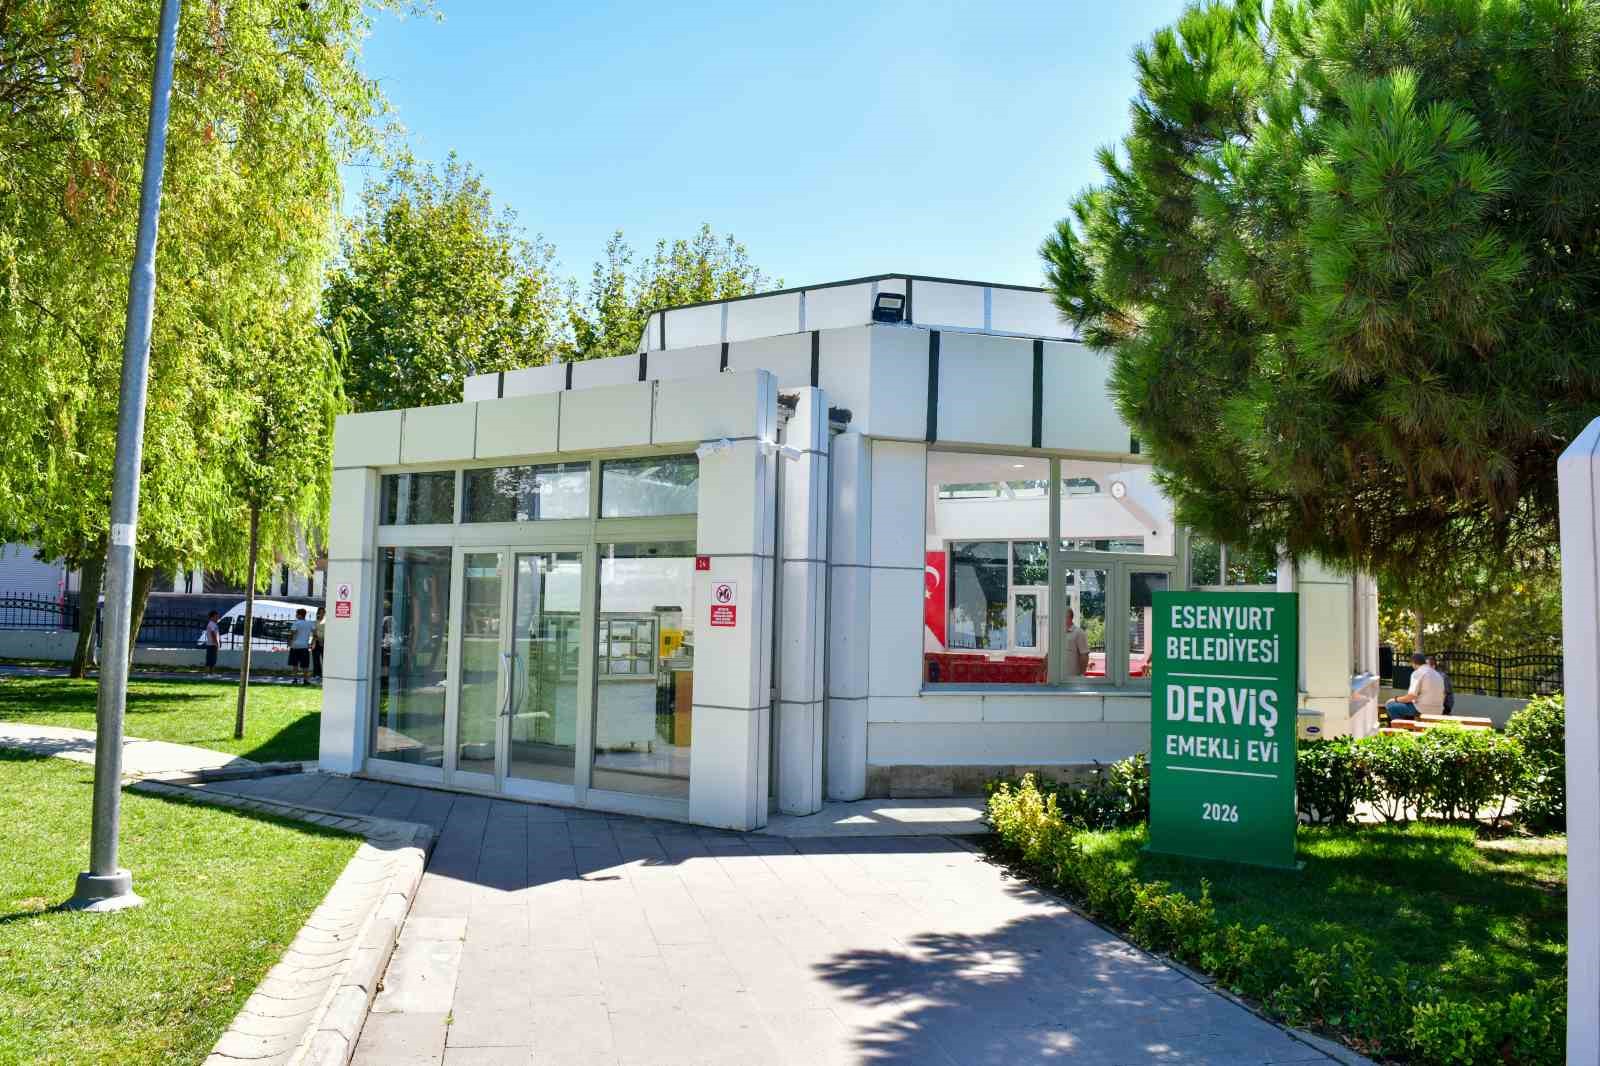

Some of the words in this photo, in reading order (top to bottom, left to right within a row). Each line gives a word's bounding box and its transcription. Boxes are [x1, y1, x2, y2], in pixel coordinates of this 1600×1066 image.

[1171, 606, 1275, 631] ESENYURT
[1167, 634, 1279, 663] BELEDİYESİ
[1166, 684, 1278, 738] DERVİŞ
[1166, 734, 1240, 760] EMEKLİ
[1247, 740, 1279, 763] EVİ
[1202, 802, 1239, 822] 2026
